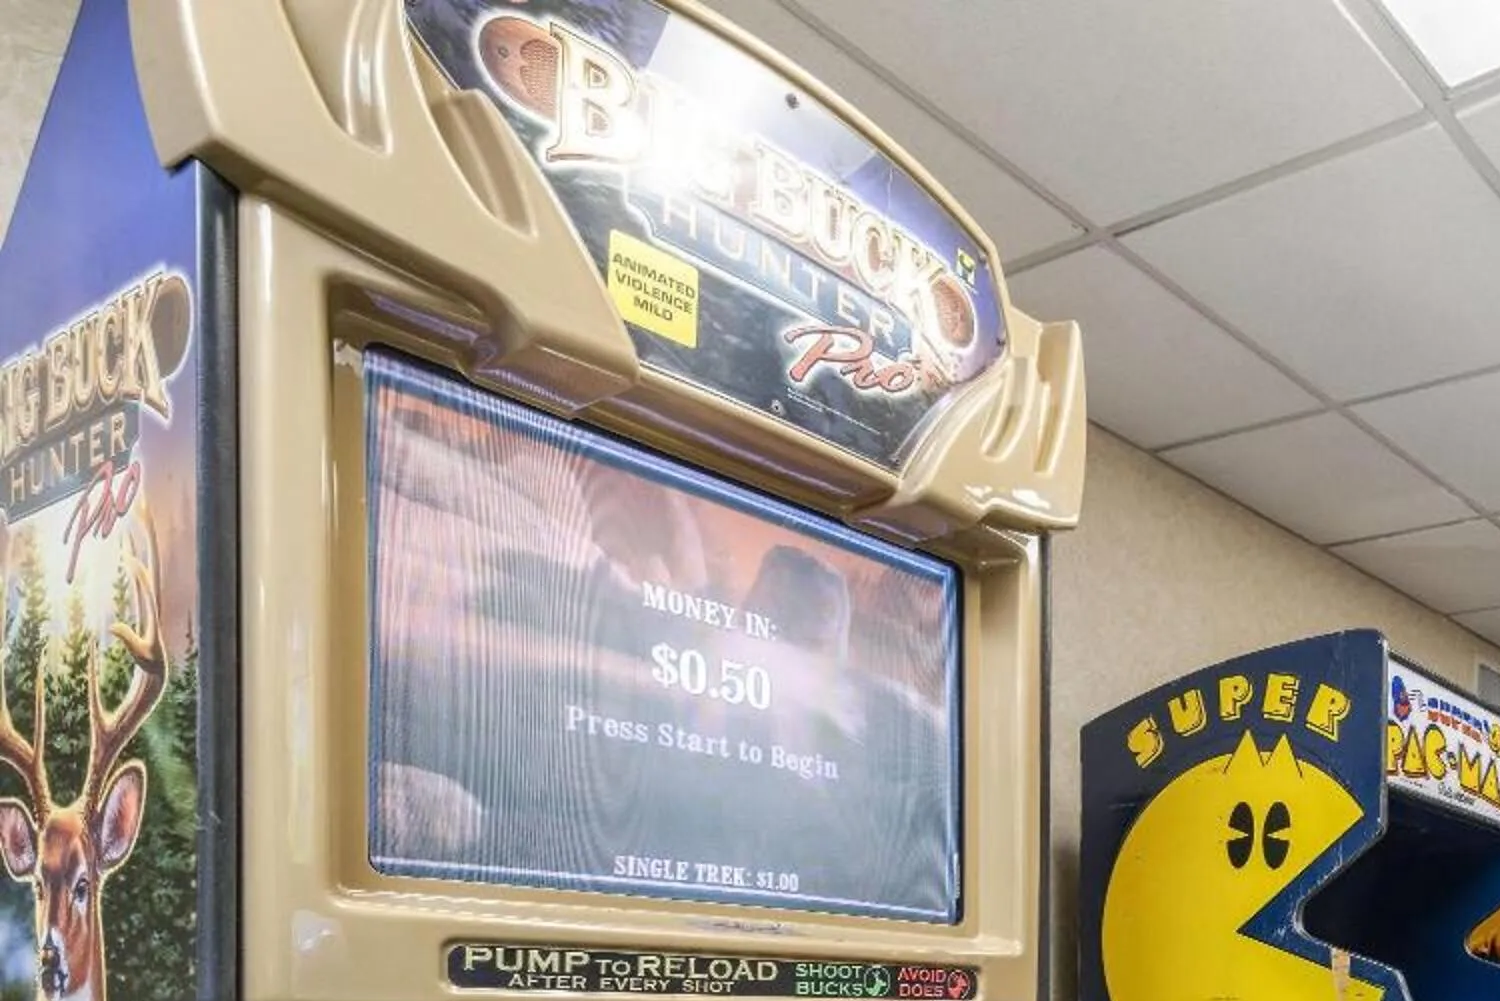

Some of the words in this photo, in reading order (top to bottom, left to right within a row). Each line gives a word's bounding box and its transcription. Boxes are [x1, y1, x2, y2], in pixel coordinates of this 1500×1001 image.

[613, 252, 696, 300] ANIMATED
[662, 190, 897, 348] HUNTER
[748, 136, 955, 376] BUCK
[615, 267, 693, 315] VIOLENCE
[633, 295, 673, 322] MILD
[44, 271, 170, 430] BUCK
[783, 325, 915, 393] Pro
[10, 411, 127, 506] HUNTER
[642, 580, 737, 630] MONEY
[746, 612, 778, 642] IN:
[650, 641, 772, 710] $0.50
[565, 703, 650, 744] Press
[657, 721, 730, 759] Start
[738, 744, 763, 764] to
[770, 744, 839, 781] Begin
[1126, 672, 1351, 769] SUPER
[613, 854, 690, 882] SINGLE
[694, 862, 754, 887] TREK:
[756, 870, 800, 893] $1.00
[462, 945, 590, 976] PUMP
[637, 954, 779, 982] RELOAD
[507, 972, 587, 991] AFTER
[599, 976, 671, 993] EVERY
[682, 978, 736, 994] SHOT
[794, 962, 863, 980] SHOOT
[896, 966, 948, 983] AVOID
[795, 980, 863, 998] BUCKS
[897, 983, 945, 999] DOES
